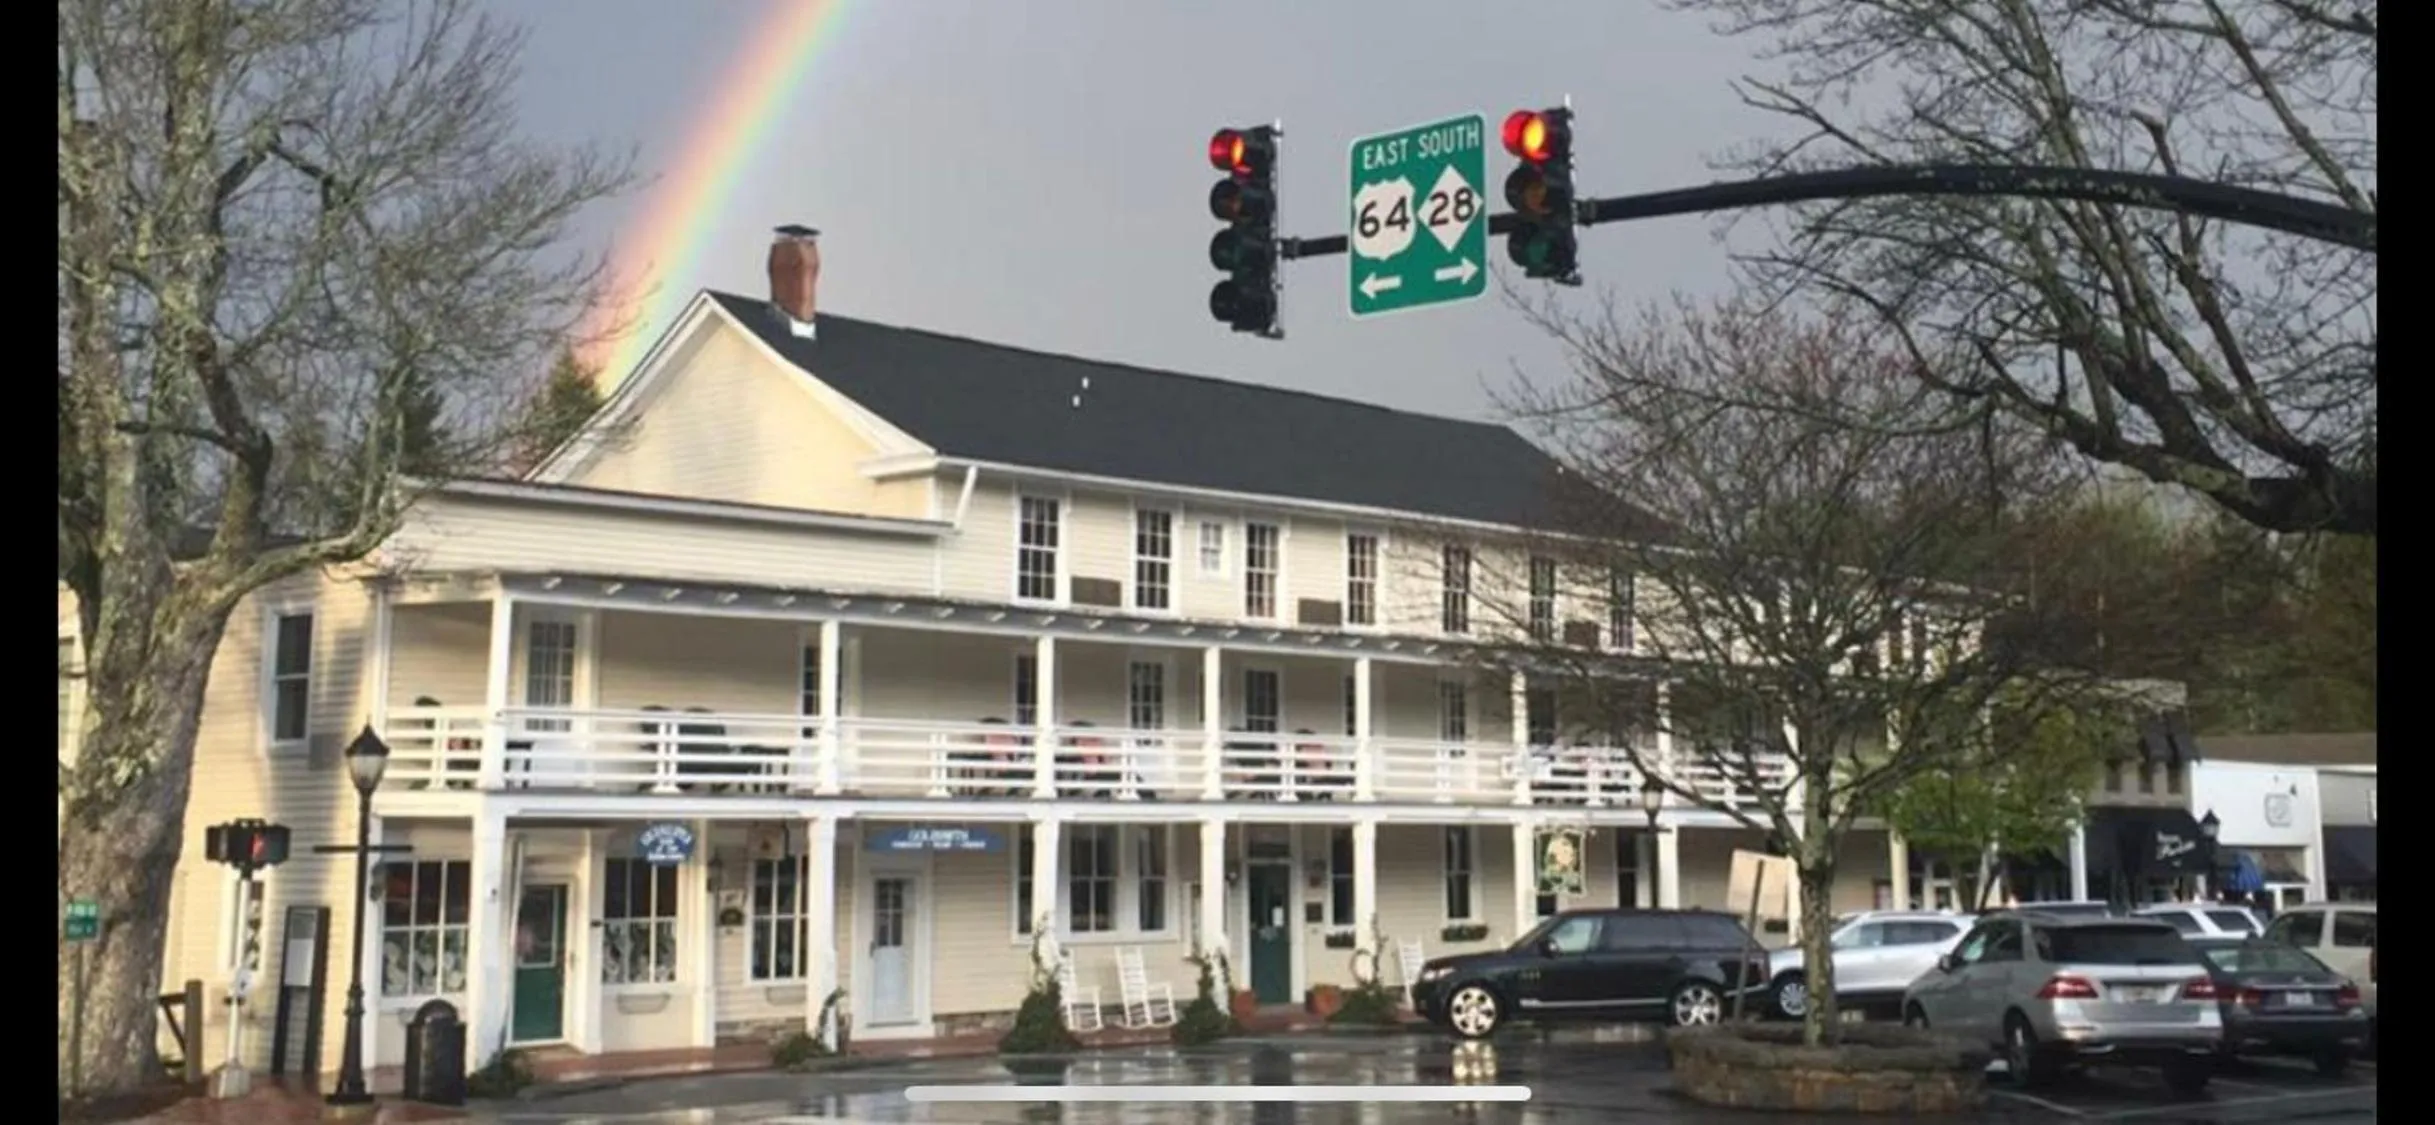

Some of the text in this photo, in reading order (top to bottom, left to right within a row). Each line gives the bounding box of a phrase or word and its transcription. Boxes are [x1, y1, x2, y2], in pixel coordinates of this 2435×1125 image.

[1363, 123, 1480, 170] EAST SOUTH
[1358, 187, 1475, 239] 64 28
